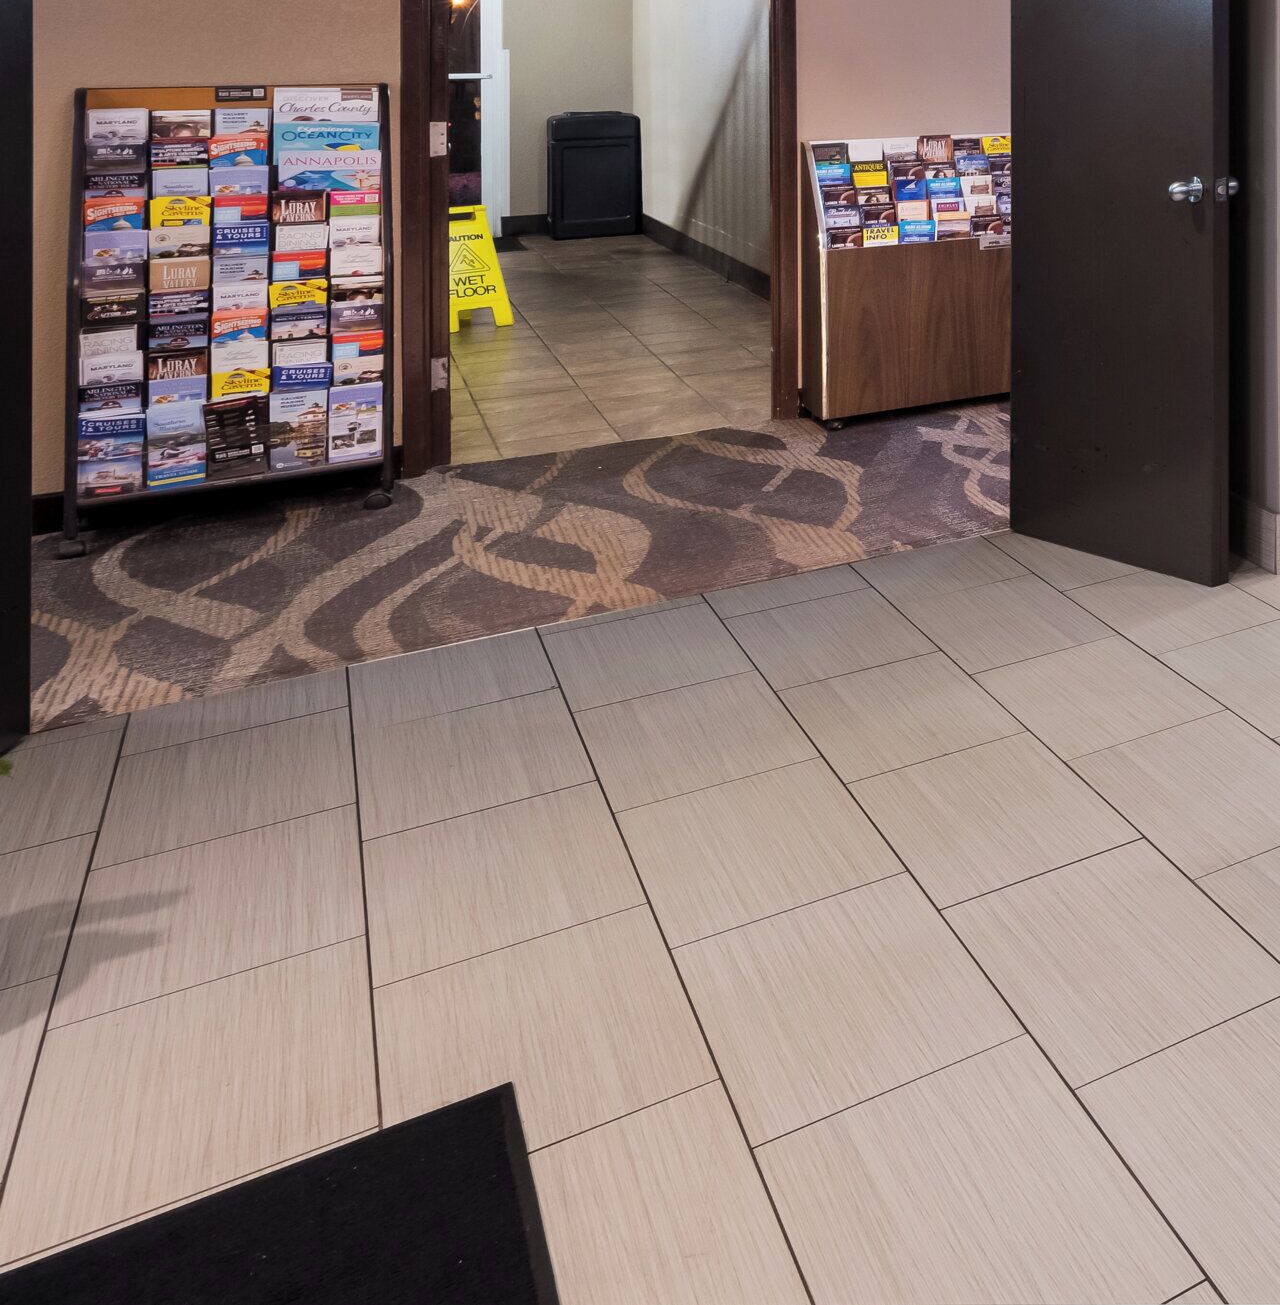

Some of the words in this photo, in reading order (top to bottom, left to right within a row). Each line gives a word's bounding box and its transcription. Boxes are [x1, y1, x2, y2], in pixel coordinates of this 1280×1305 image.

[279, 102, 326, 113] Charles
[327, 102, 373, 115] County
[283, 156, 377, 166] ANNAPOLIS
[854, 163, 884, 171] ANTIQUES
[280, 199, 317, 215] LURAY
[279, 213, 317, 223] CAVERNS
[449, 233, 484, 243] AUTION
[163, 265, 197, 280] LURAY
[163, 278, 197, 288] VALLEY
[453, 274, 486, 287] WET
[449, 284, 497, 299] FLOOR
[90, 363, 134, 371] MARYLAND
[157, 358, 198, 373] LURAY
[224, 377, 262, 385] Skyline
[85, 385, 136, 394] ARLINGTON
[221, 382, 263, 391] Caverns
